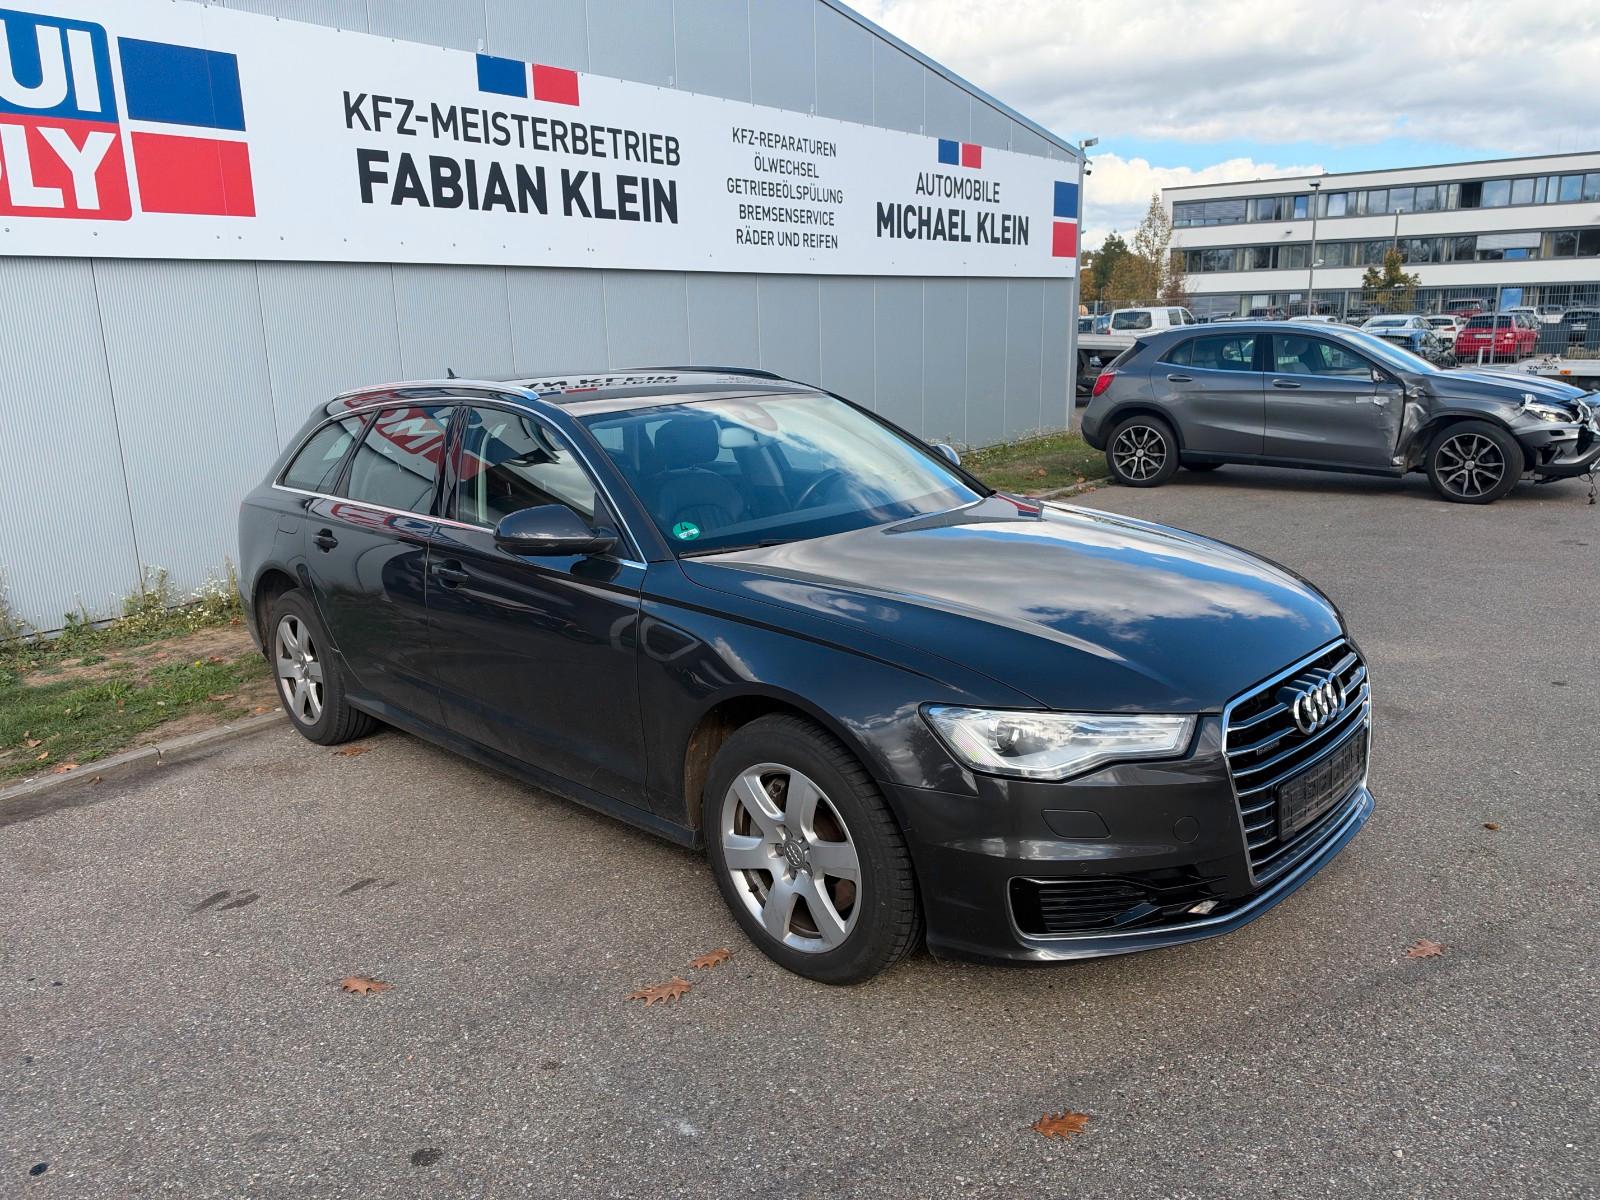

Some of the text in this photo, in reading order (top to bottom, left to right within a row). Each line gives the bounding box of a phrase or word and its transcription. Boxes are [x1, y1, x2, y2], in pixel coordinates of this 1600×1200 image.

[343, 91, 681, 167] KFZ-MEISTERBETRIEB
[732, 127, 837, 158] KFZ-REPARATUREN
[0, 123, 116, 211] LY
[754, 152, 820, 179] ÖLWECHSEL
[356, 147, 679, 225] FABIAN KLEIN
[726, 177, 844, 204] GETRIEBEÖLSPÜLUNG
[915, 171, 1001, 204] AUTOMOBILE
[739, 203, 835, 227] BREMSENSERVICE
[876, 201, 1030, 246] MICHAEL KLEIN
[736, 226, 838, 249] RÄDER UND REIFEN
